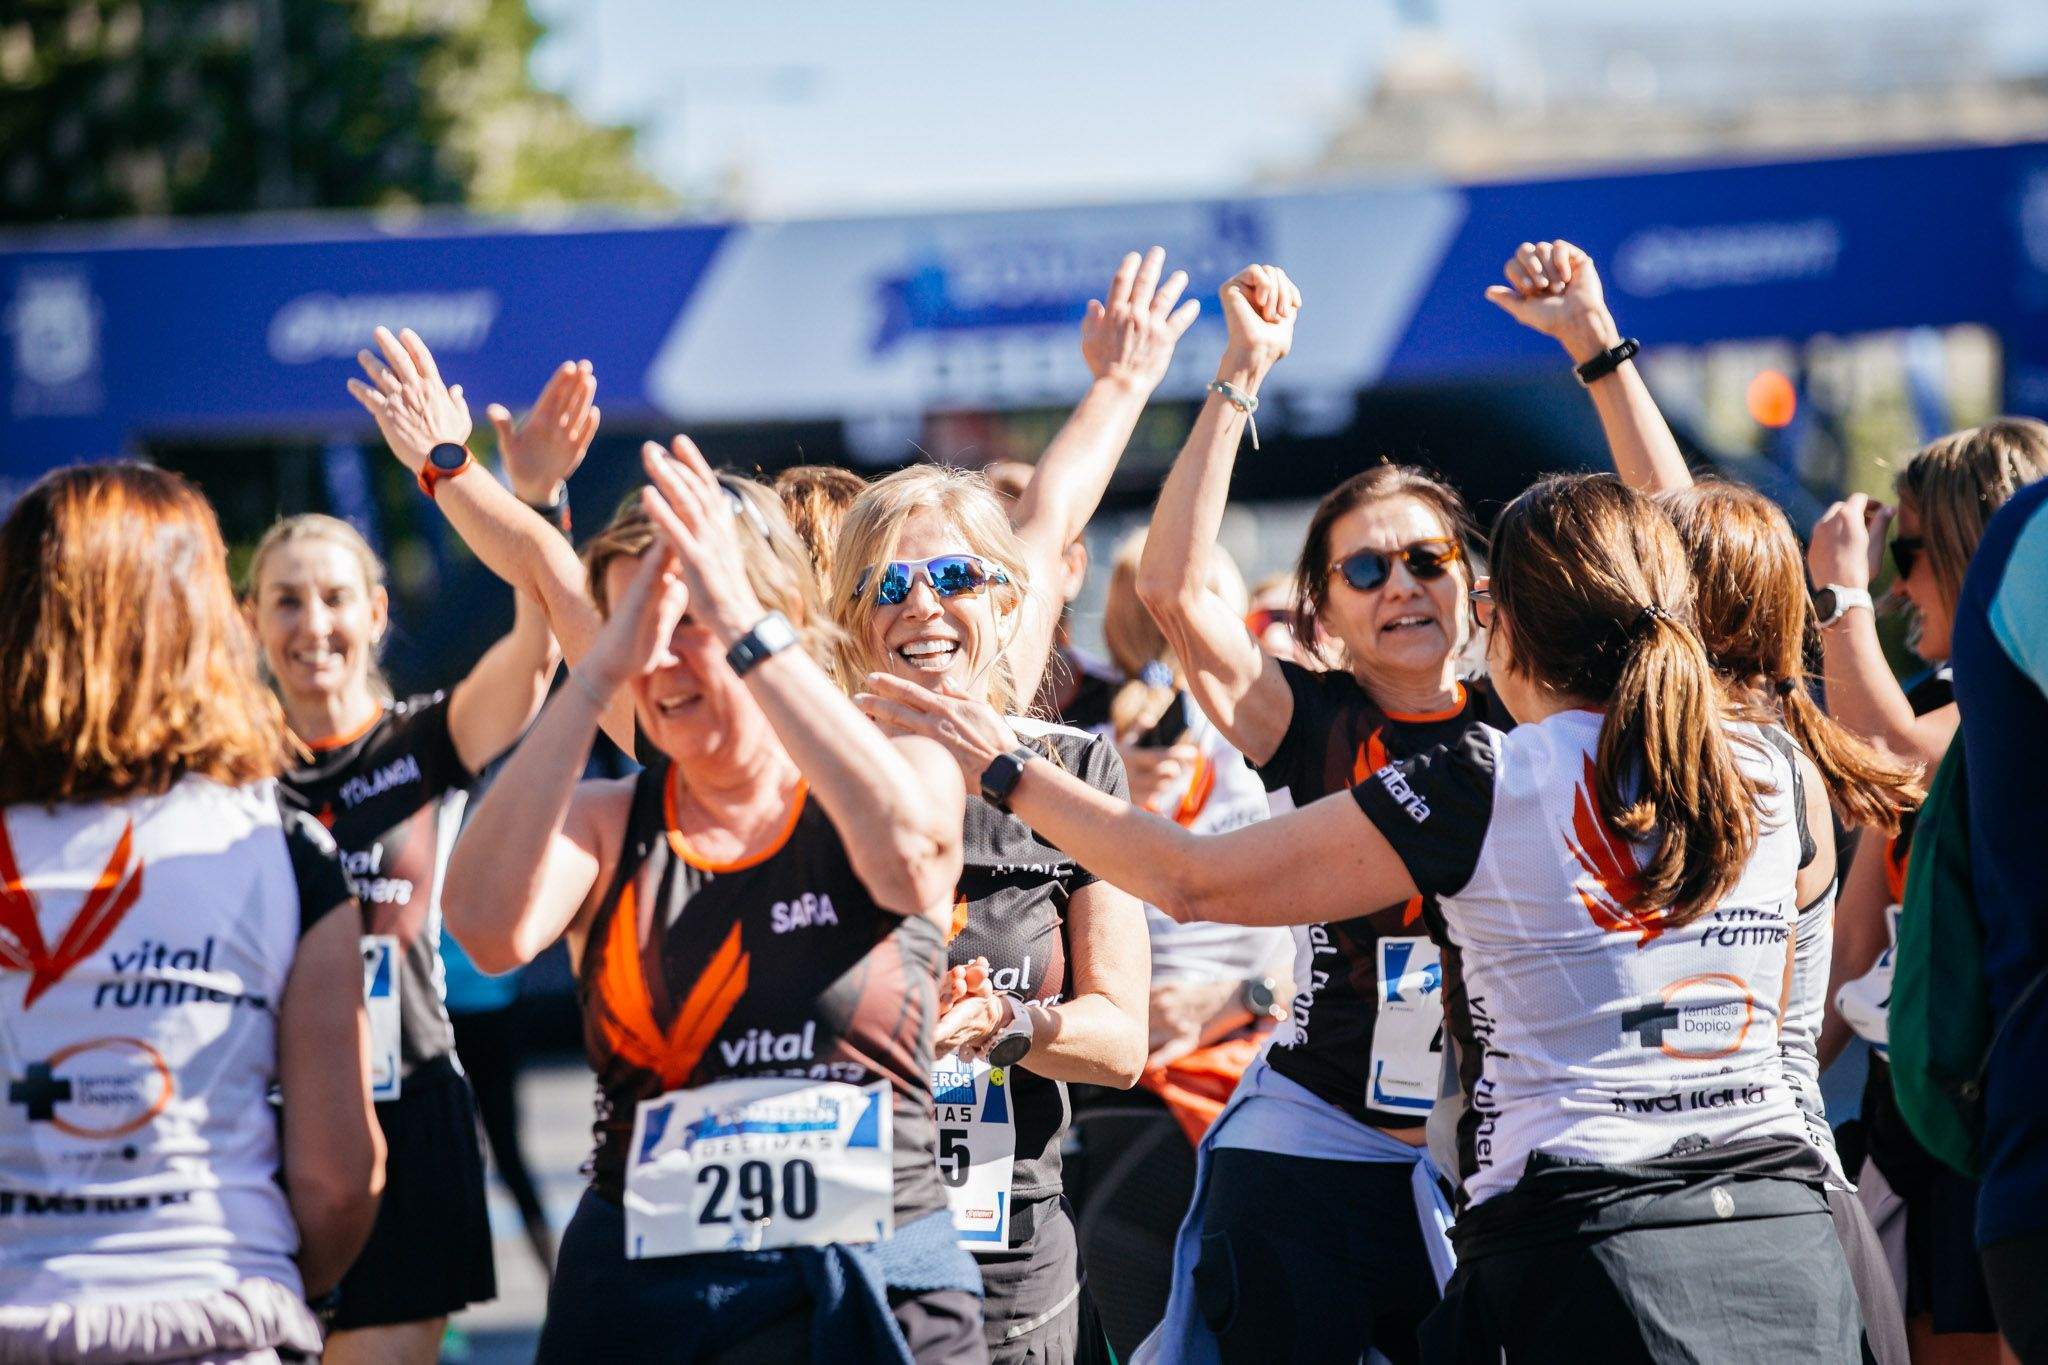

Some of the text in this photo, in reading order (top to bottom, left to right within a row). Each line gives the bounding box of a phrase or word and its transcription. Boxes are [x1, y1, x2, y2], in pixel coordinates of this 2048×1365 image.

[770, 892, 839, 934] SARA
[111, 936, 214, 973] vital
[719, 1021, 816, 1068] vital
[1684, 1019, 1731, 1034] Dopico
[698, 1159, 818, 1223] 290
